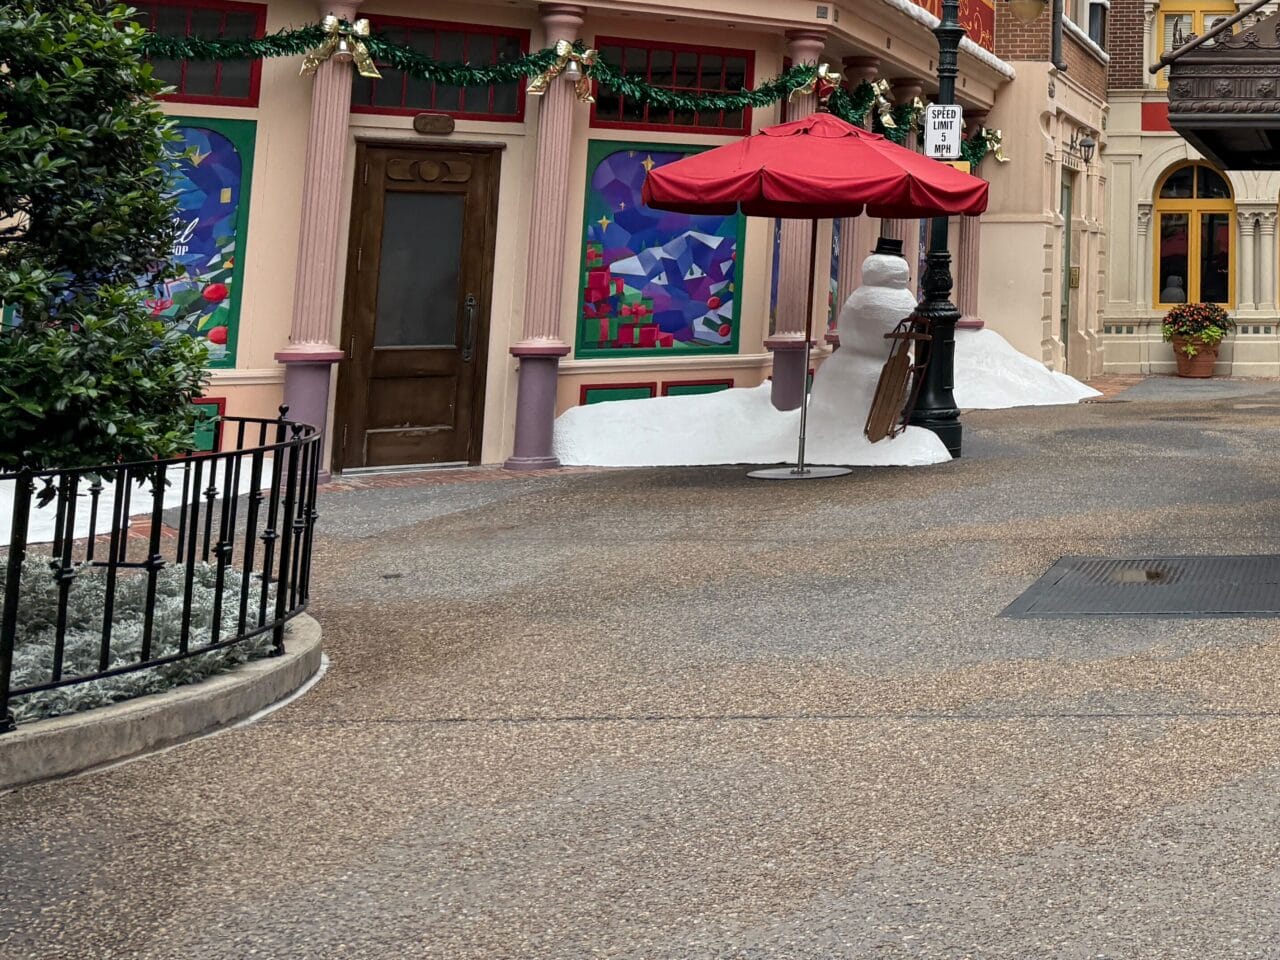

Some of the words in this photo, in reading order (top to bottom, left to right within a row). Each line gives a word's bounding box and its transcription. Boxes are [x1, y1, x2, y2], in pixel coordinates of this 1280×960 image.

[931, 109, 957, 120] SPEED
[933, 120, 954, 131] LIMIT
[941, 132, 947, 143] 5
[934, 143, 952, 154] MPH
